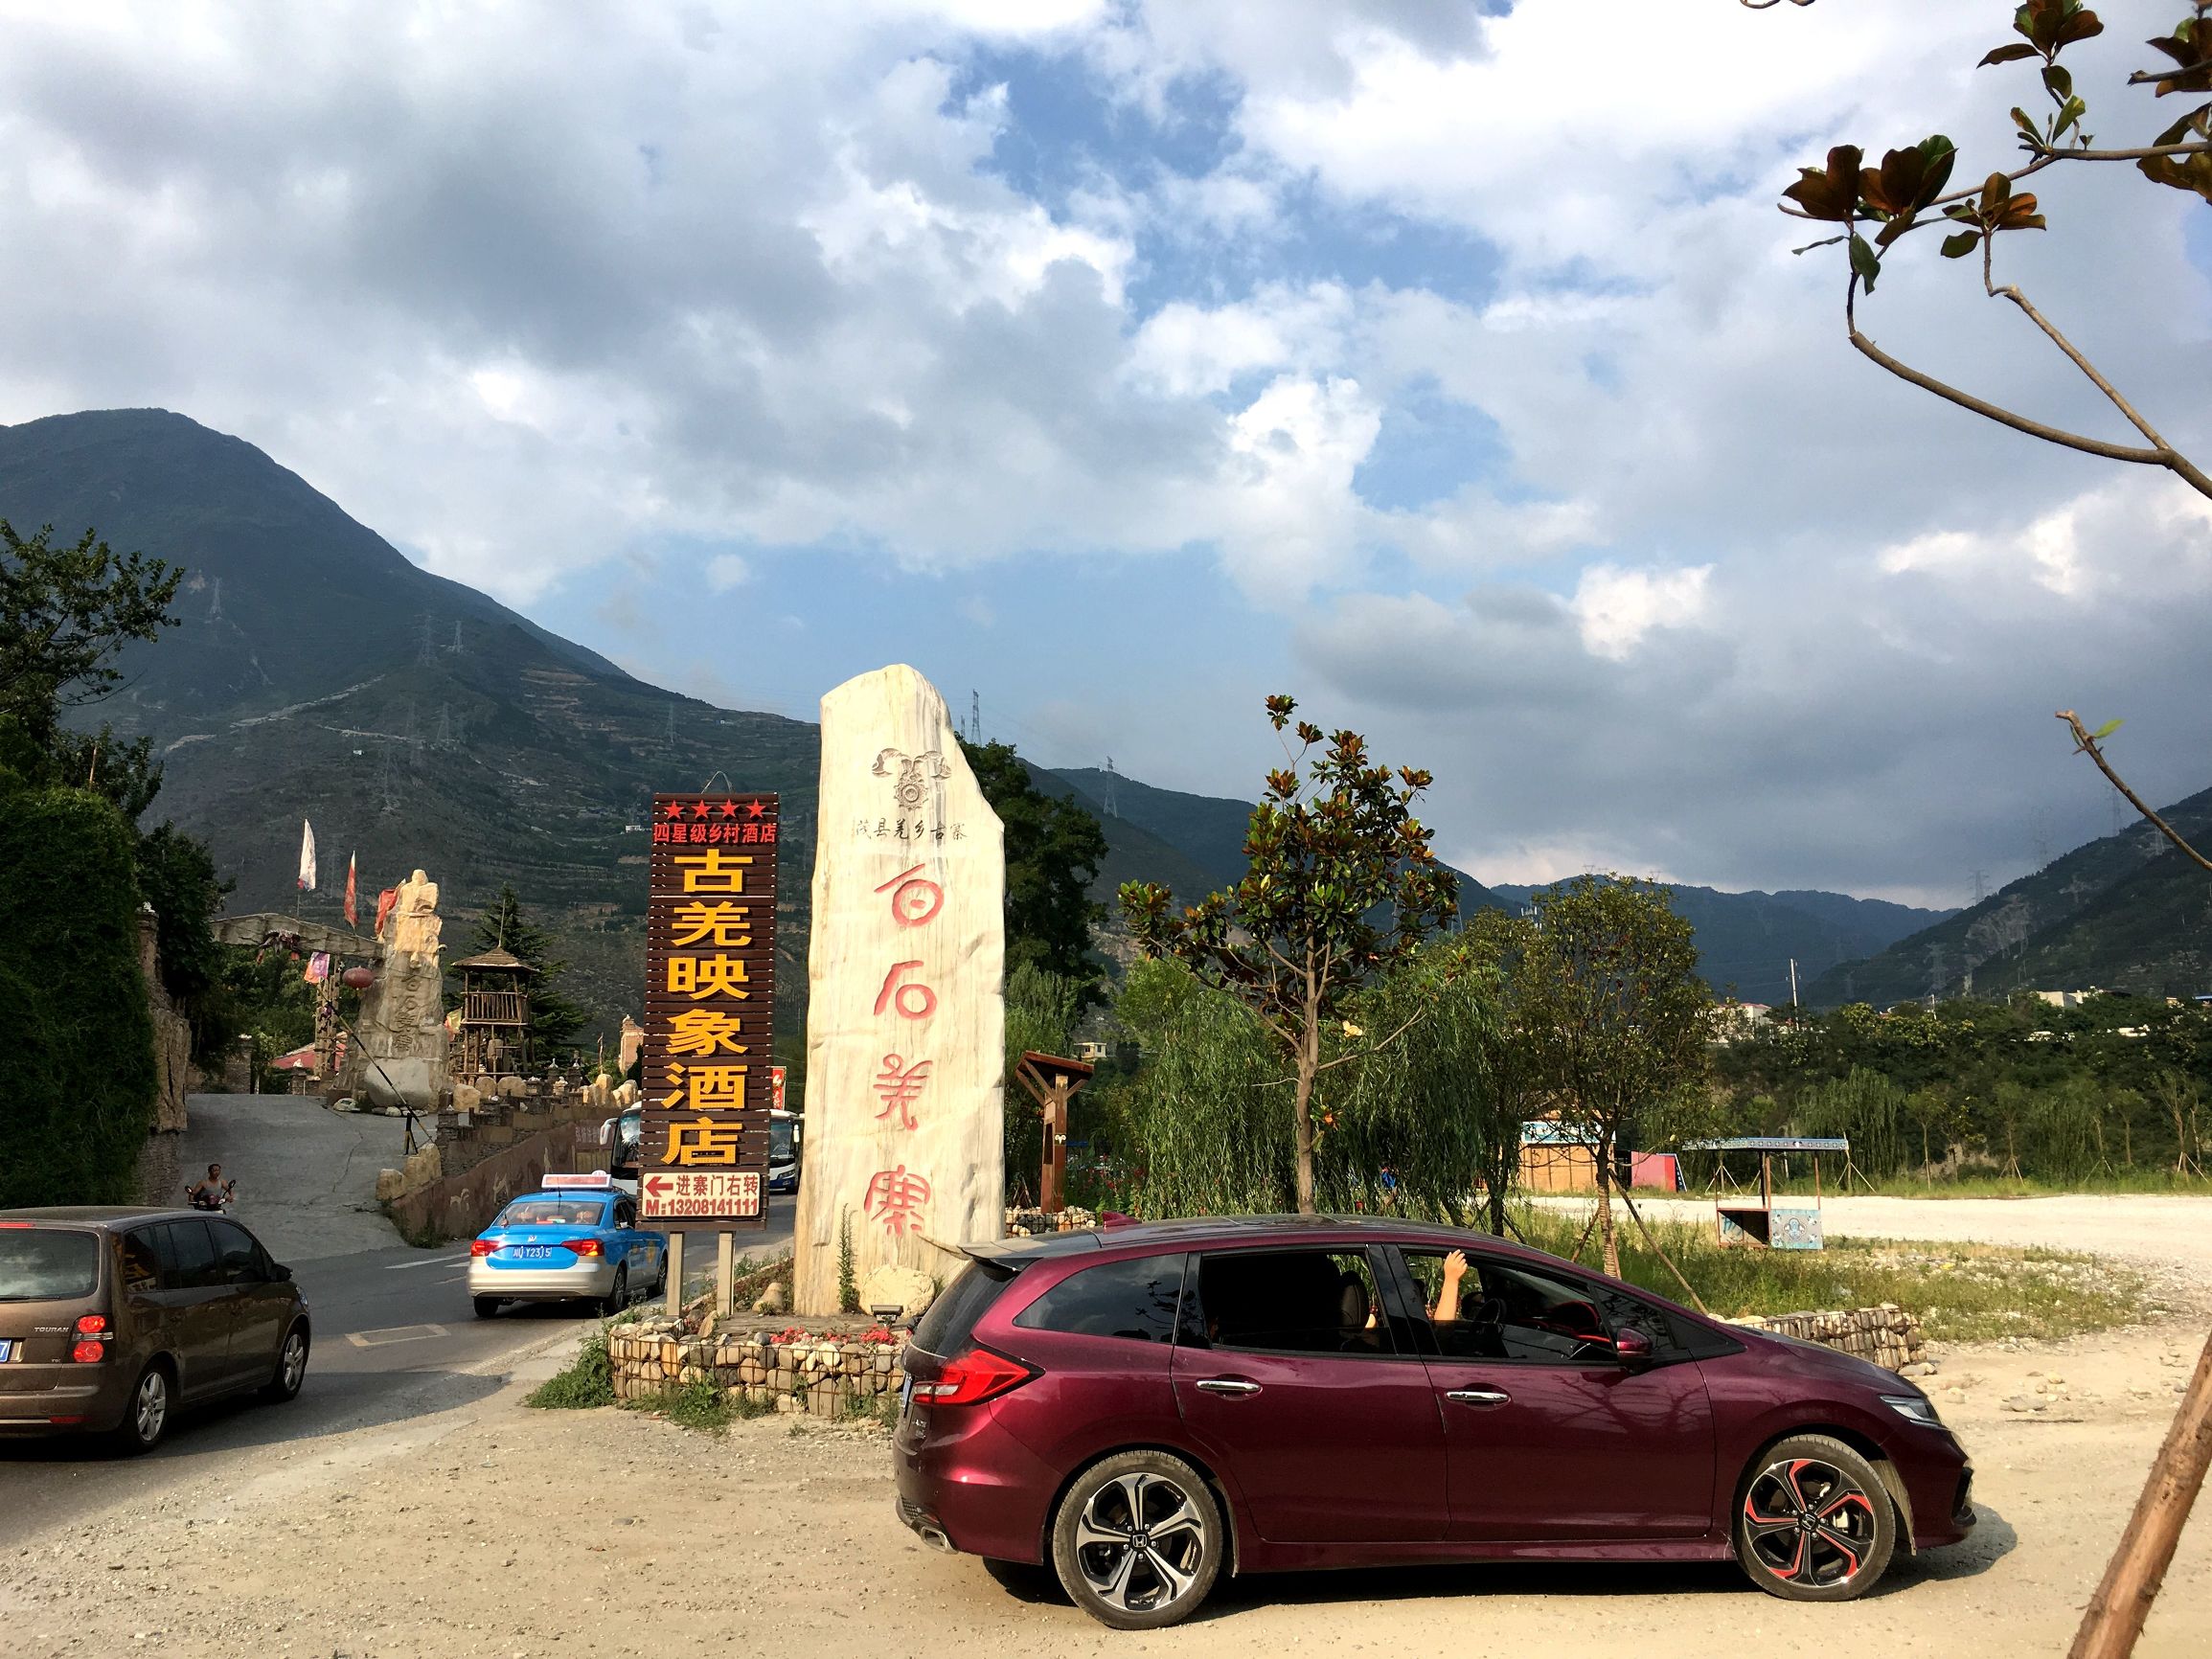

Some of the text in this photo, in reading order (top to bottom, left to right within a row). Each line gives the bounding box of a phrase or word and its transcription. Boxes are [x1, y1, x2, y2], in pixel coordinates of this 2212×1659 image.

[653, 823, 777, 844] 四星级乡村酒店
[660, 849, 754, 1166] 古羌映象酒店
[864, 863, 945, 1238] 白石羌寨
[675, 1174, 759, 1197] 进寨门右转
[645, 1198, 759, 1216] M:13208141111
